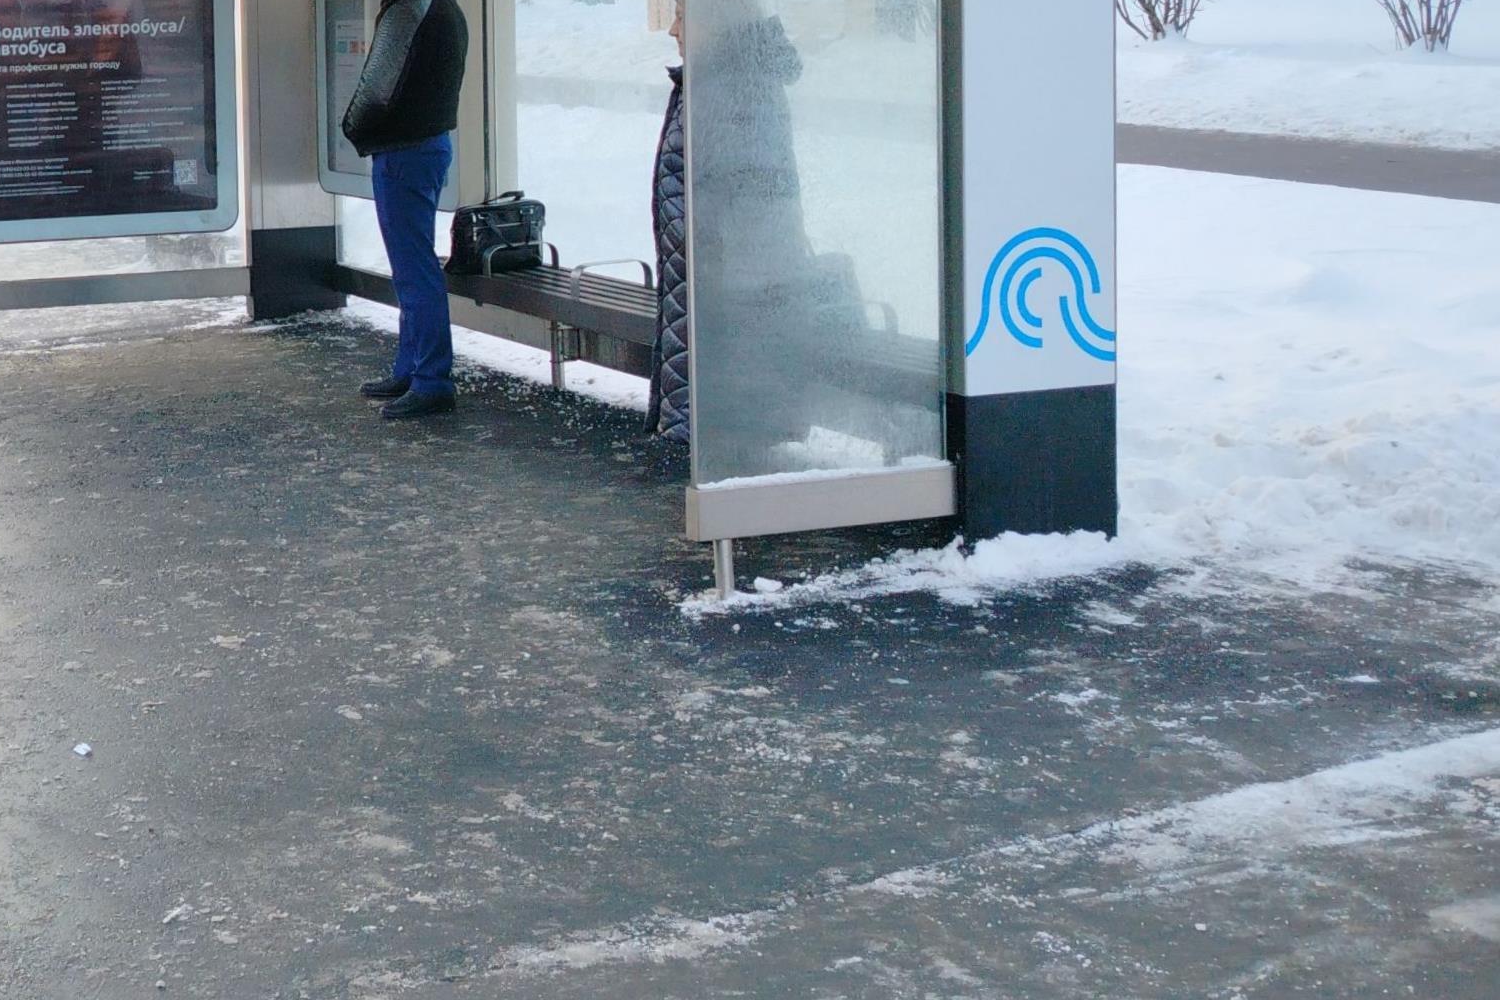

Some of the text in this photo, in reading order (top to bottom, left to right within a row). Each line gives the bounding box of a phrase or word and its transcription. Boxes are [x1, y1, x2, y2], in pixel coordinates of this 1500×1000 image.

[74, 16, 186, 37] электробуса/
[9, 62, 58, 74] профессия
[89, 60, 121, 71] городу
